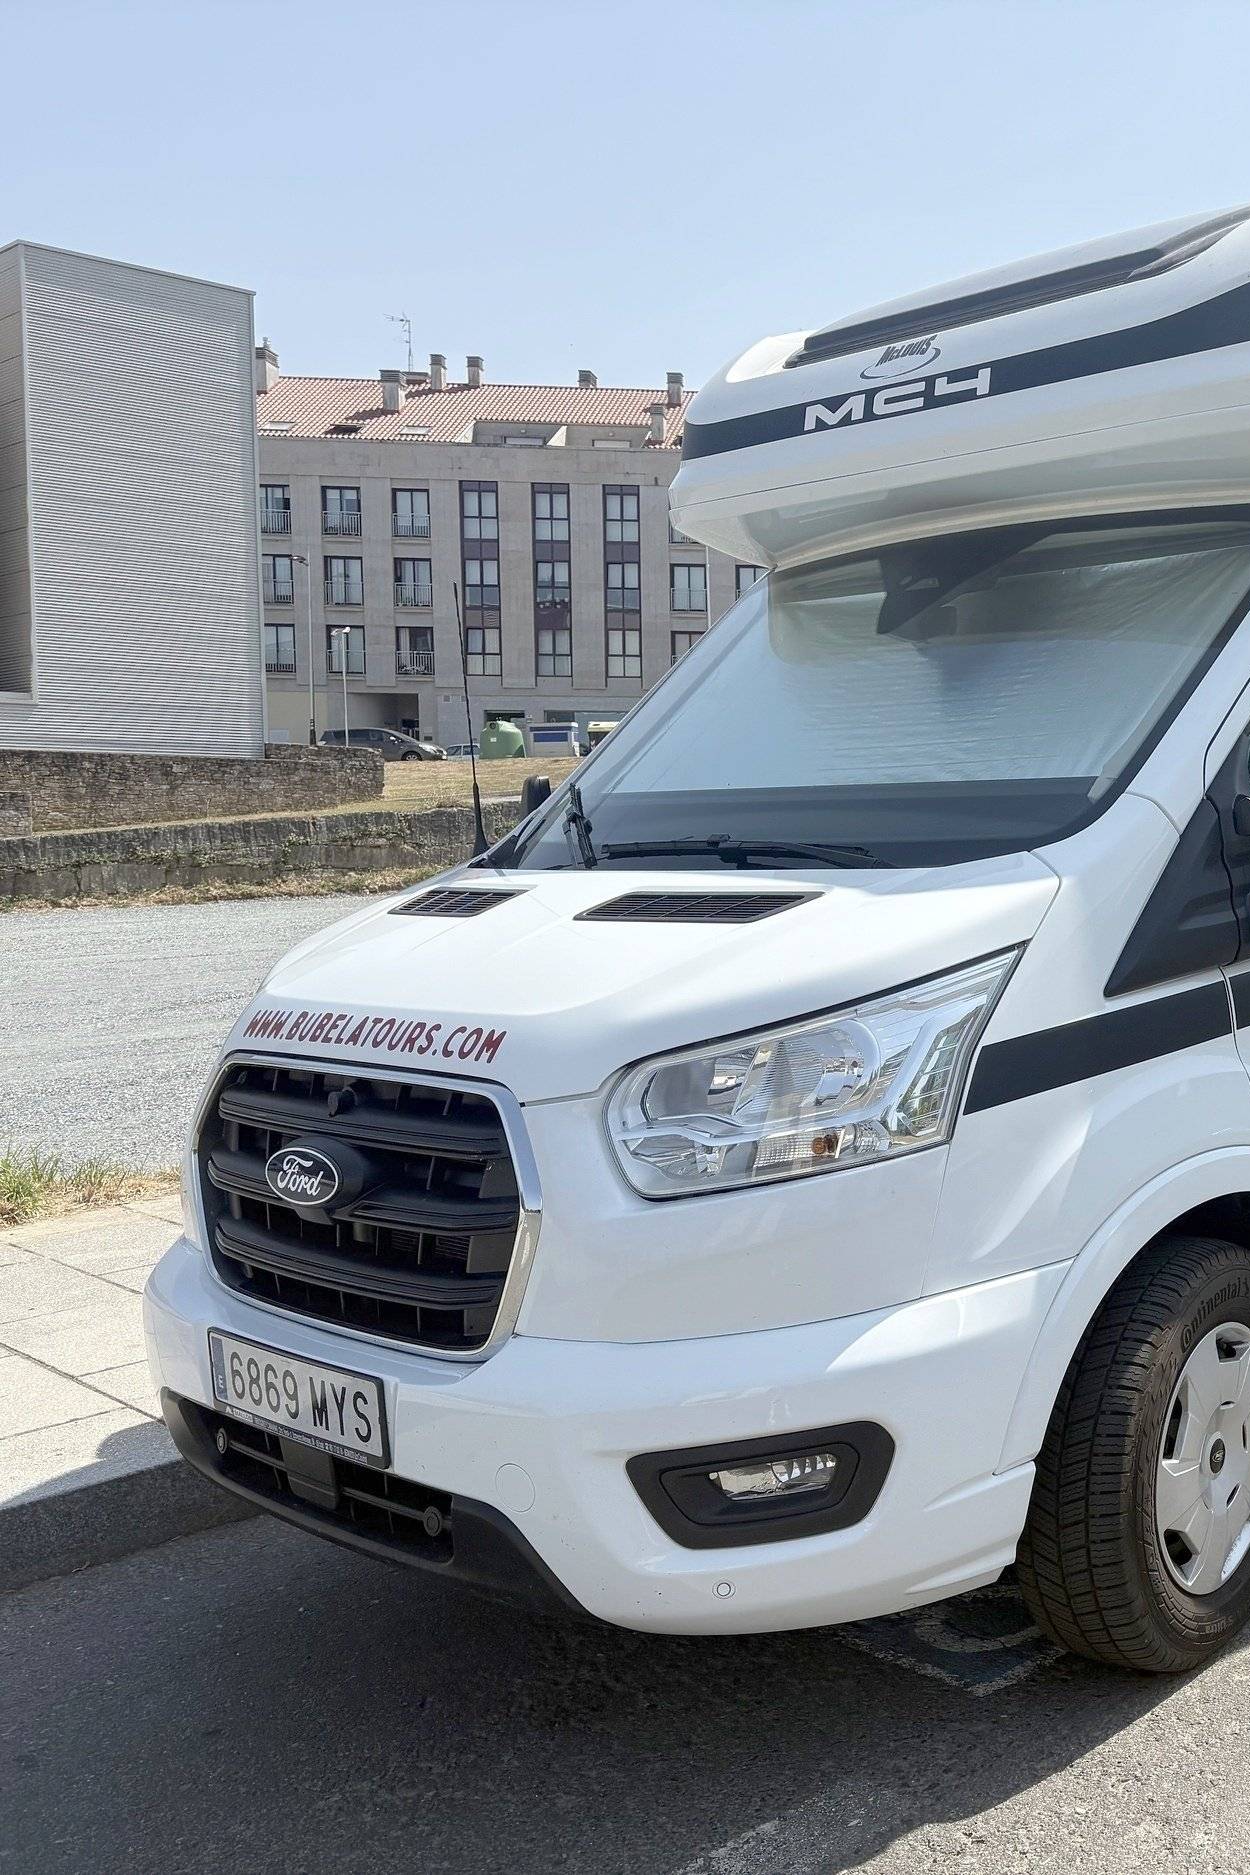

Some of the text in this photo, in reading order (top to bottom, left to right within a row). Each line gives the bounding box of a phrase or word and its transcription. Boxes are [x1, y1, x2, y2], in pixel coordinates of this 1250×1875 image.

[243, 1009, 507, 1063] WWW.BUBELATOURS.COM
[277, 1155, 322, 1196] Ford
[230, 1352, 299, 1419] 6869
[309, 1376, 372, 1443] MYS
